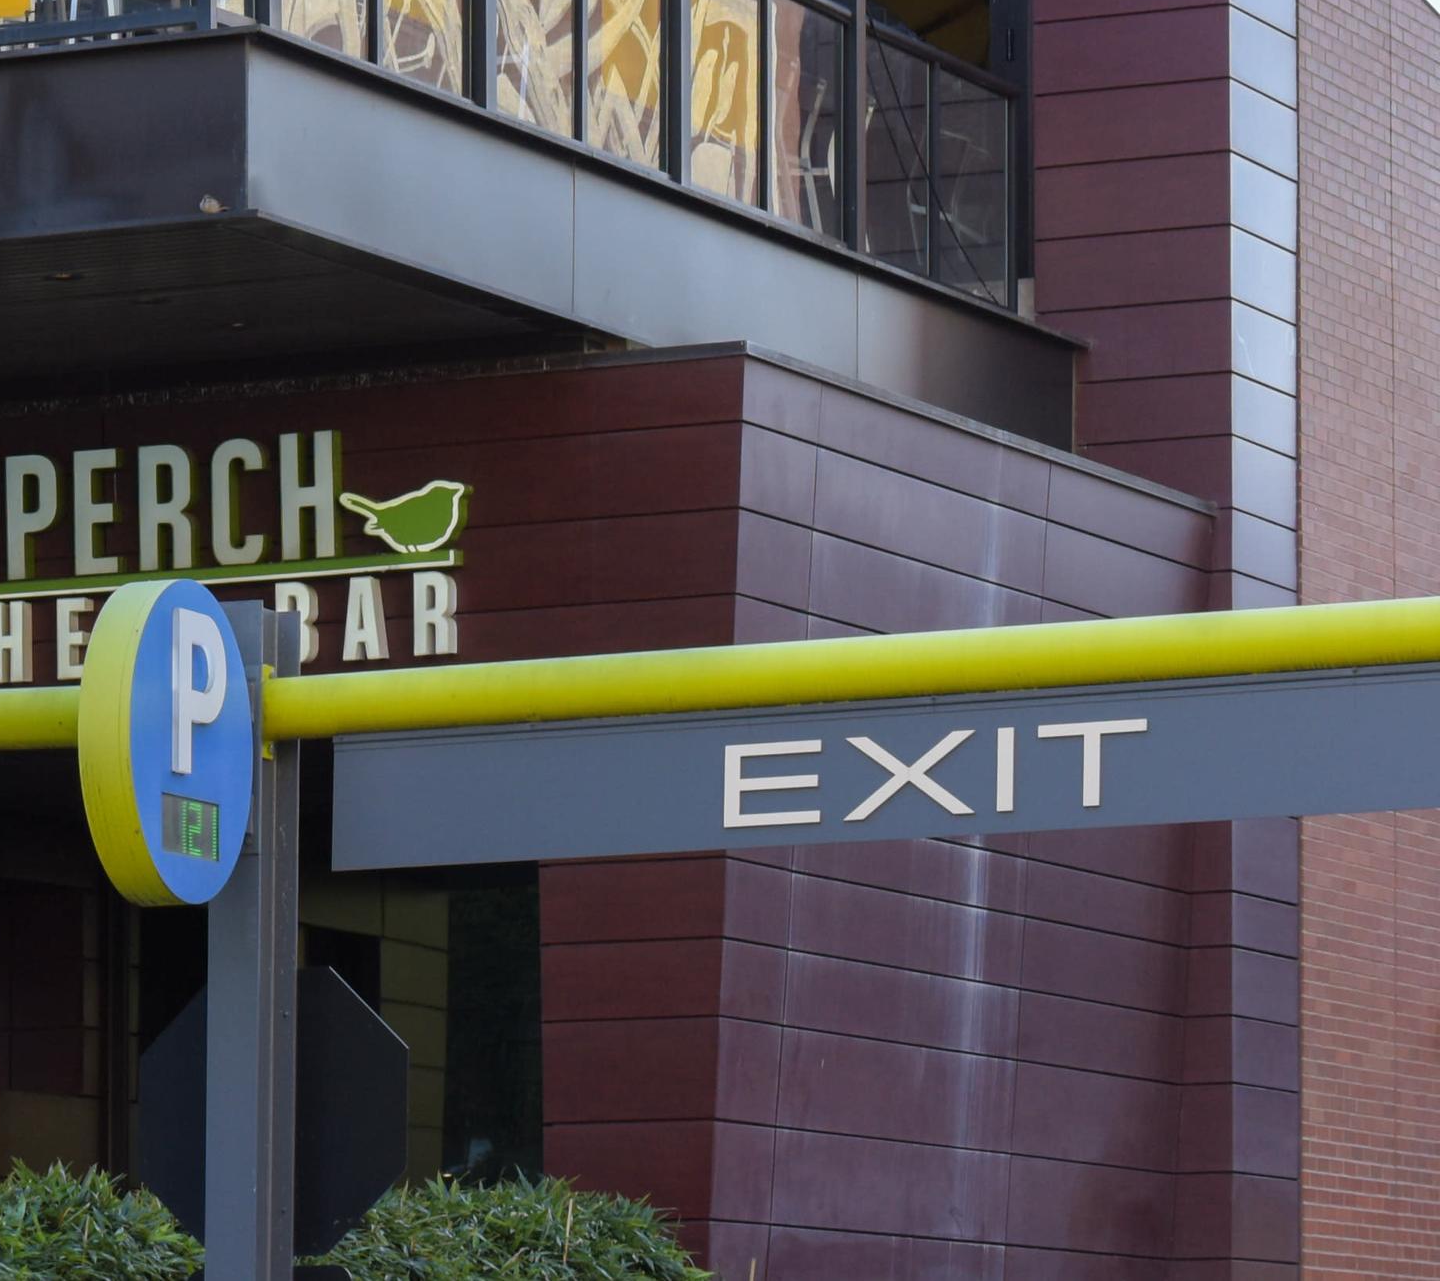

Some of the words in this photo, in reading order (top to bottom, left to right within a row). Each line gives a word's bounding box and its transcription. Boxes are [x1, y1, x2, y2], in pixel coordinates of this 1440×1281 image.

[5, 429, 344, 582] PERCH
[171, 607, 228, 775] P
[724, 718, 1148, 828] EXIT
